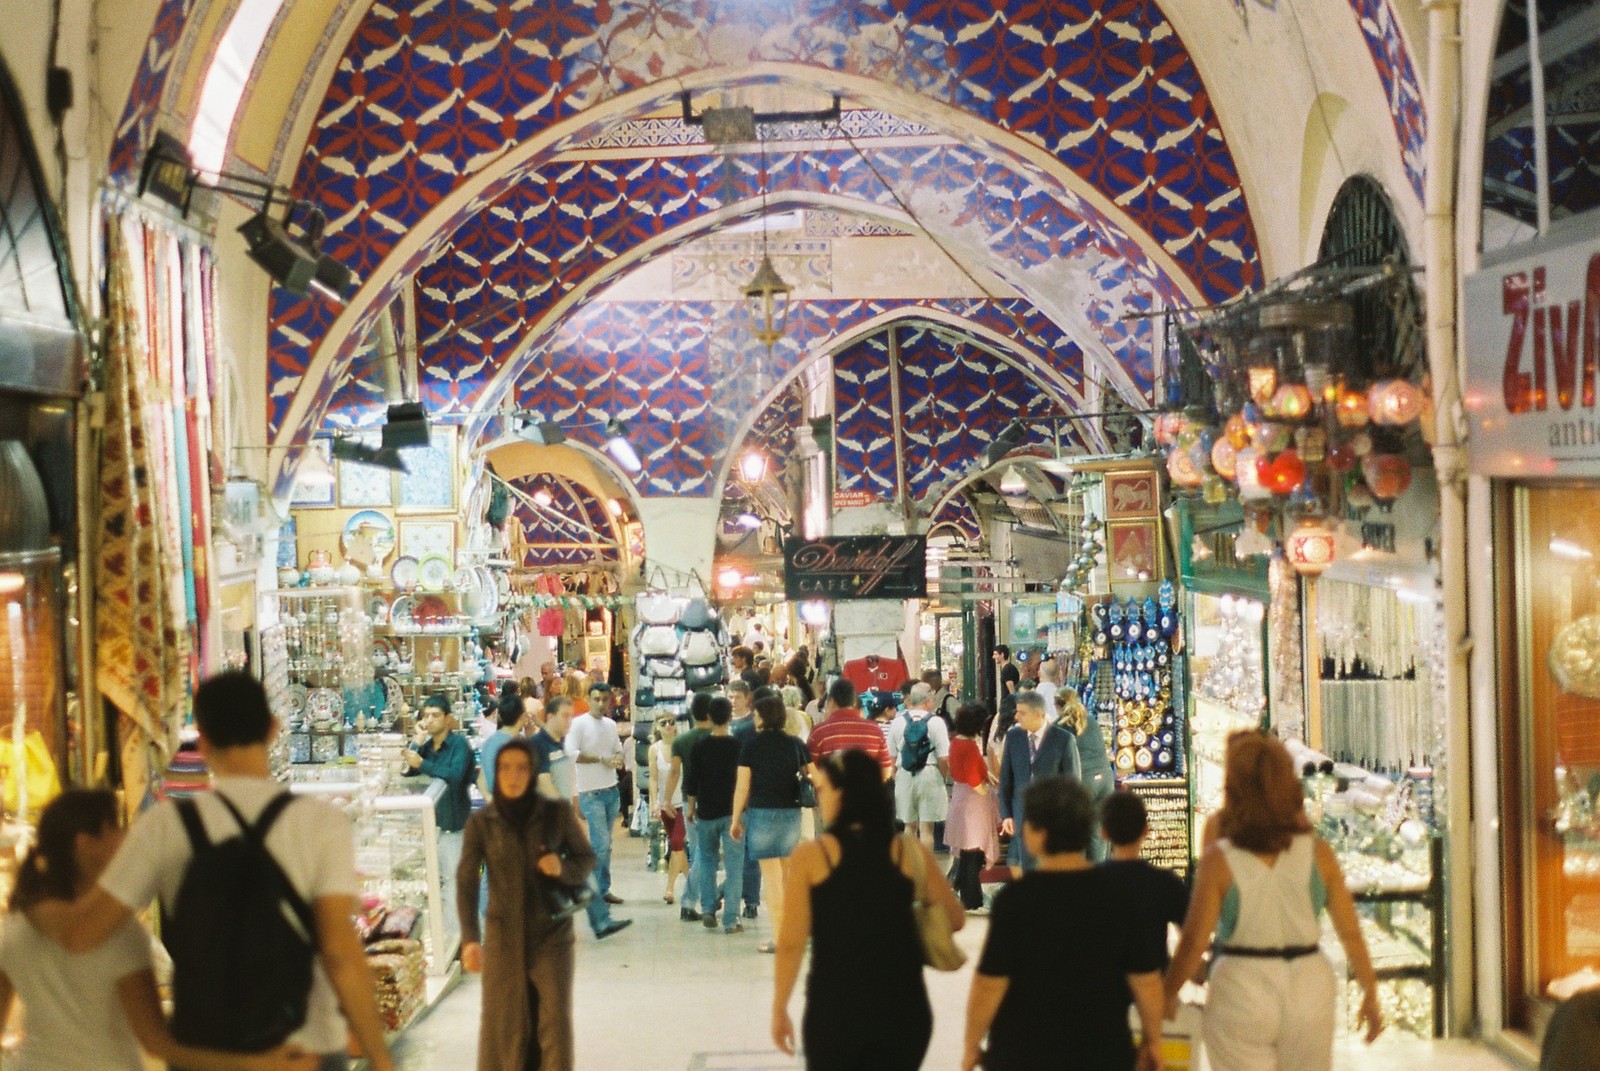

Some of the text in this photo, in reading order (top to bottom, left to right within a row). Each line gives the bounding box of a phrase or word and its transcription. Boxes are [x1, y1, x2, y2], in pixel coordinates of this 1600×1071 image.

[1549, 418, 1600, 447] anti
[833, 491, 864, 499] CAVIAR
[799, 579, 849, 592] CAFE
